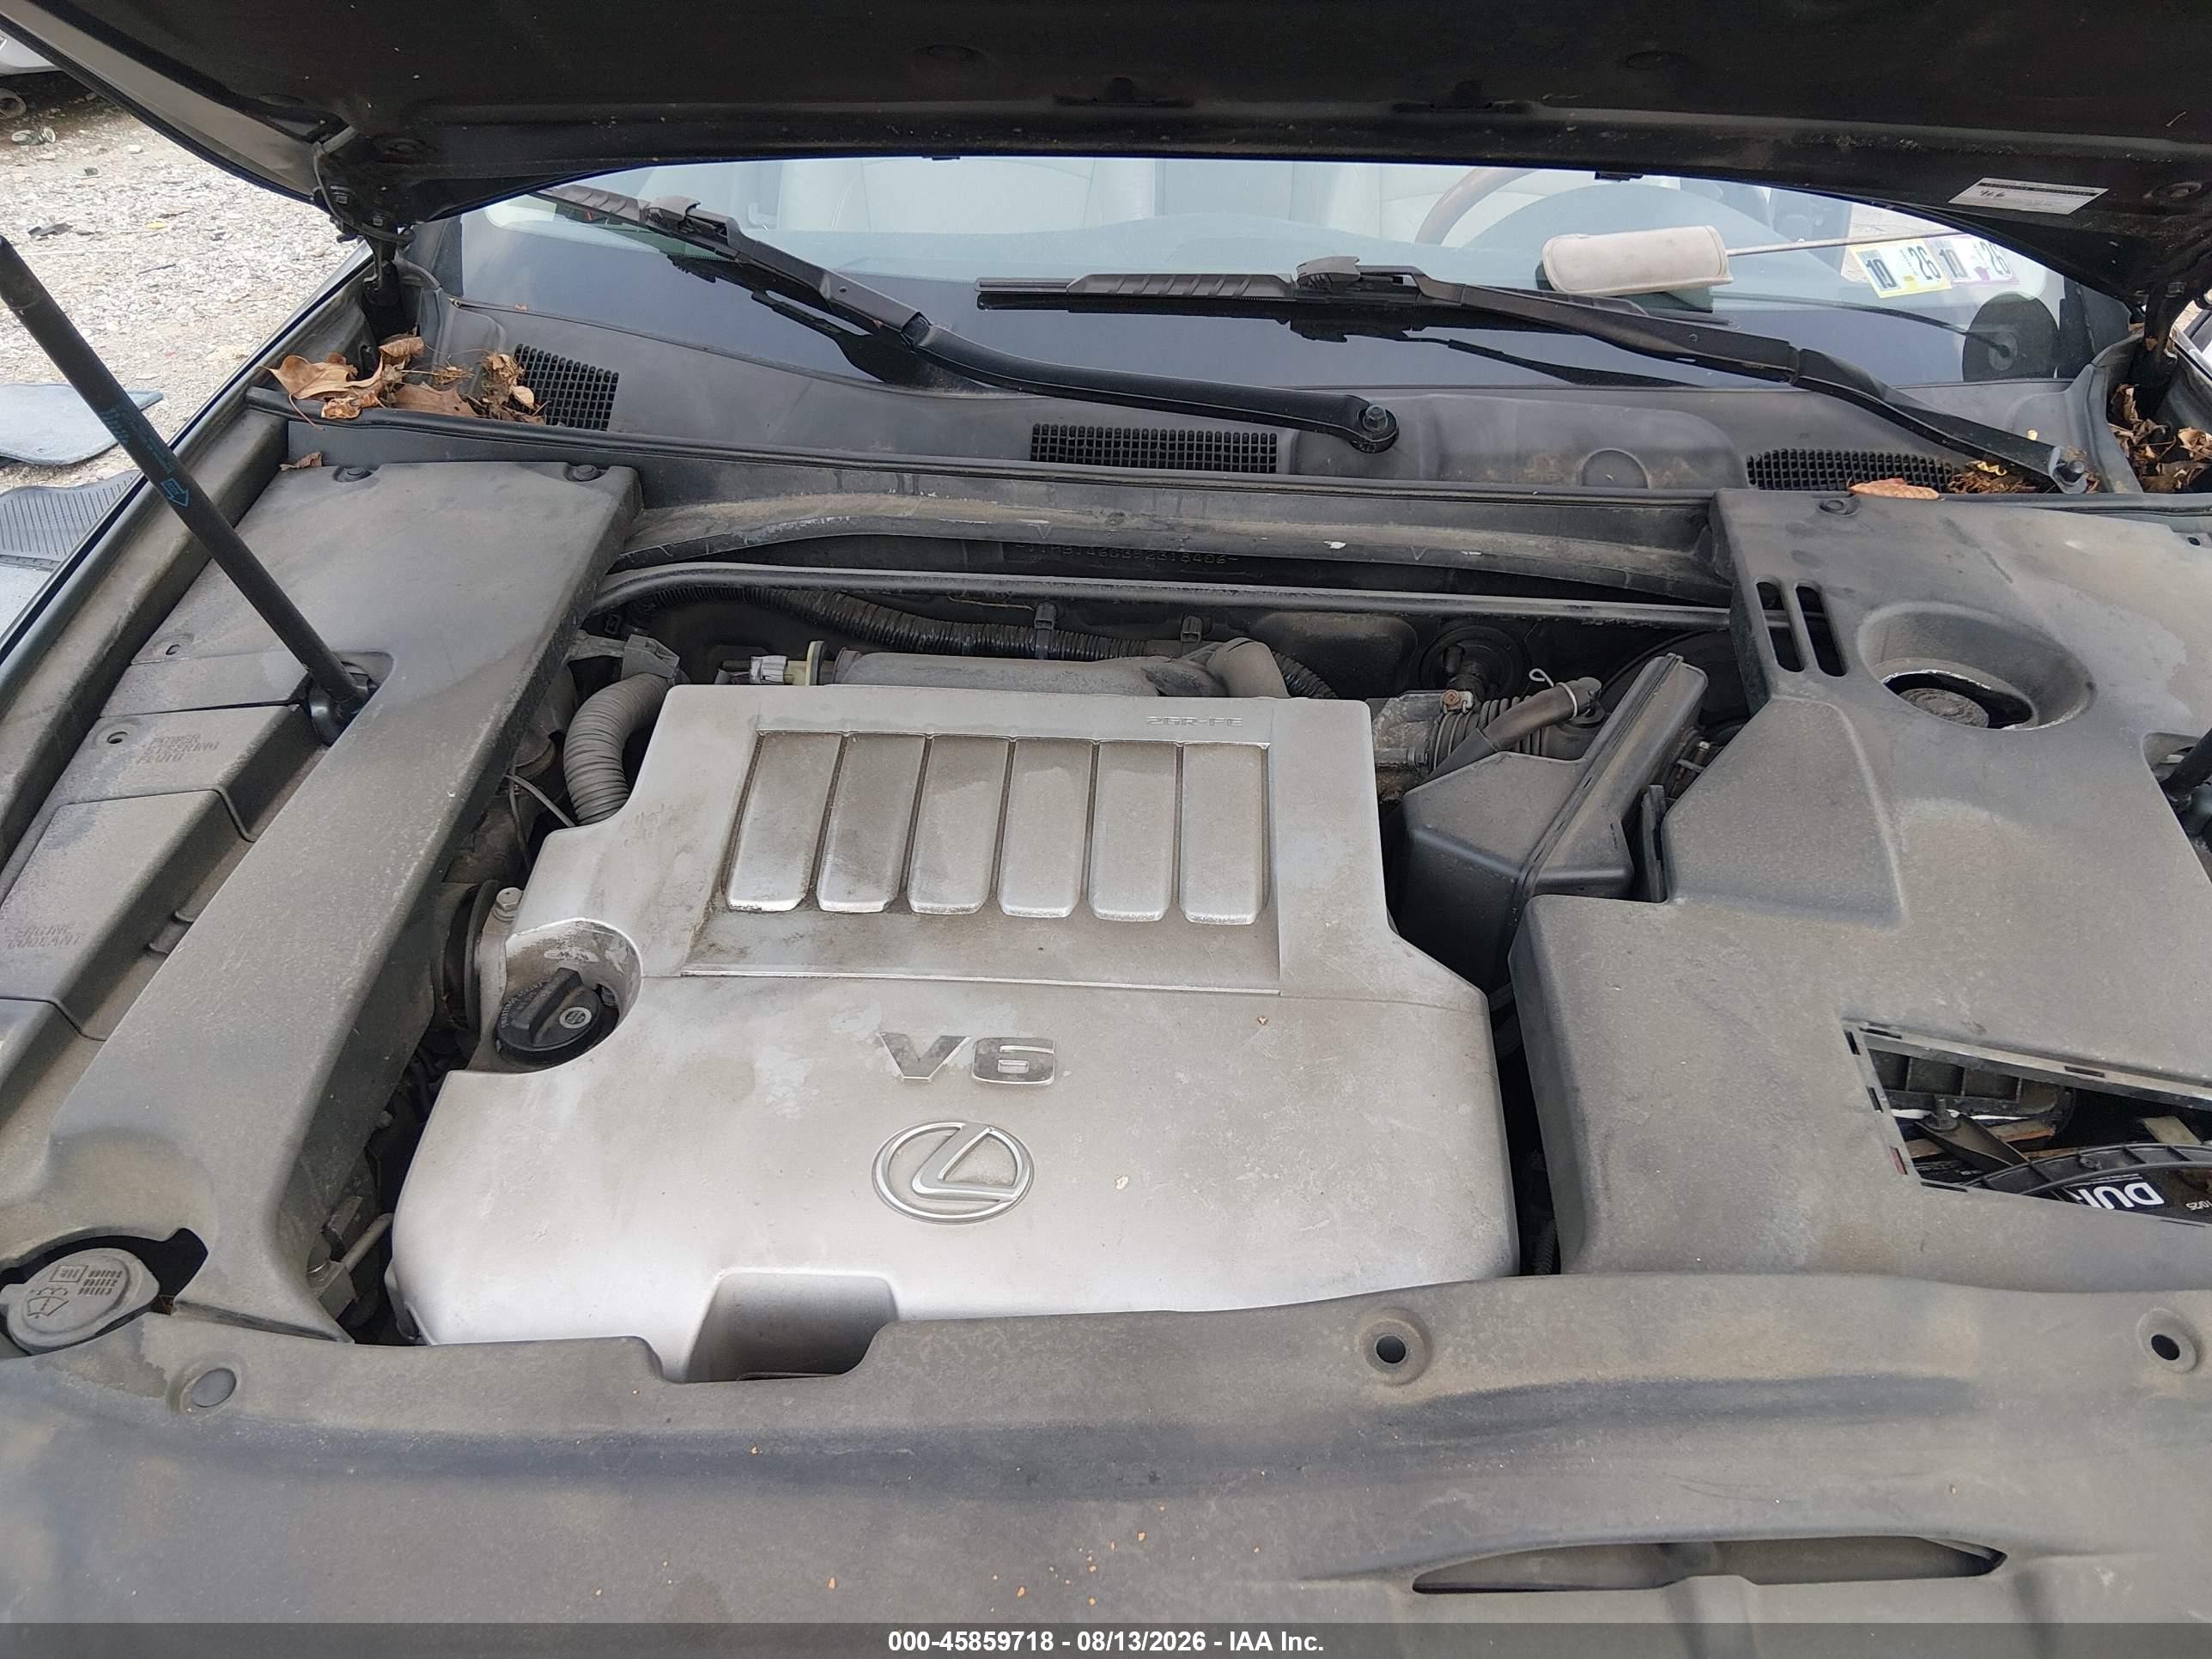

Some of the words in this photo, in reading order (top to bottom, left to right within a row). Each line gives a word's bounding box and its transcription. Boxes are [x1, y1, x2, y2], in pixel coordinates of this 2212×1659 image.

[1866, 258, 1898, 290] 10
[1908, 246, 1942, 281] 26
[1146, 715, 1244, 727] 2GR-FE
[877, 1030, 1056, 1086] V6
